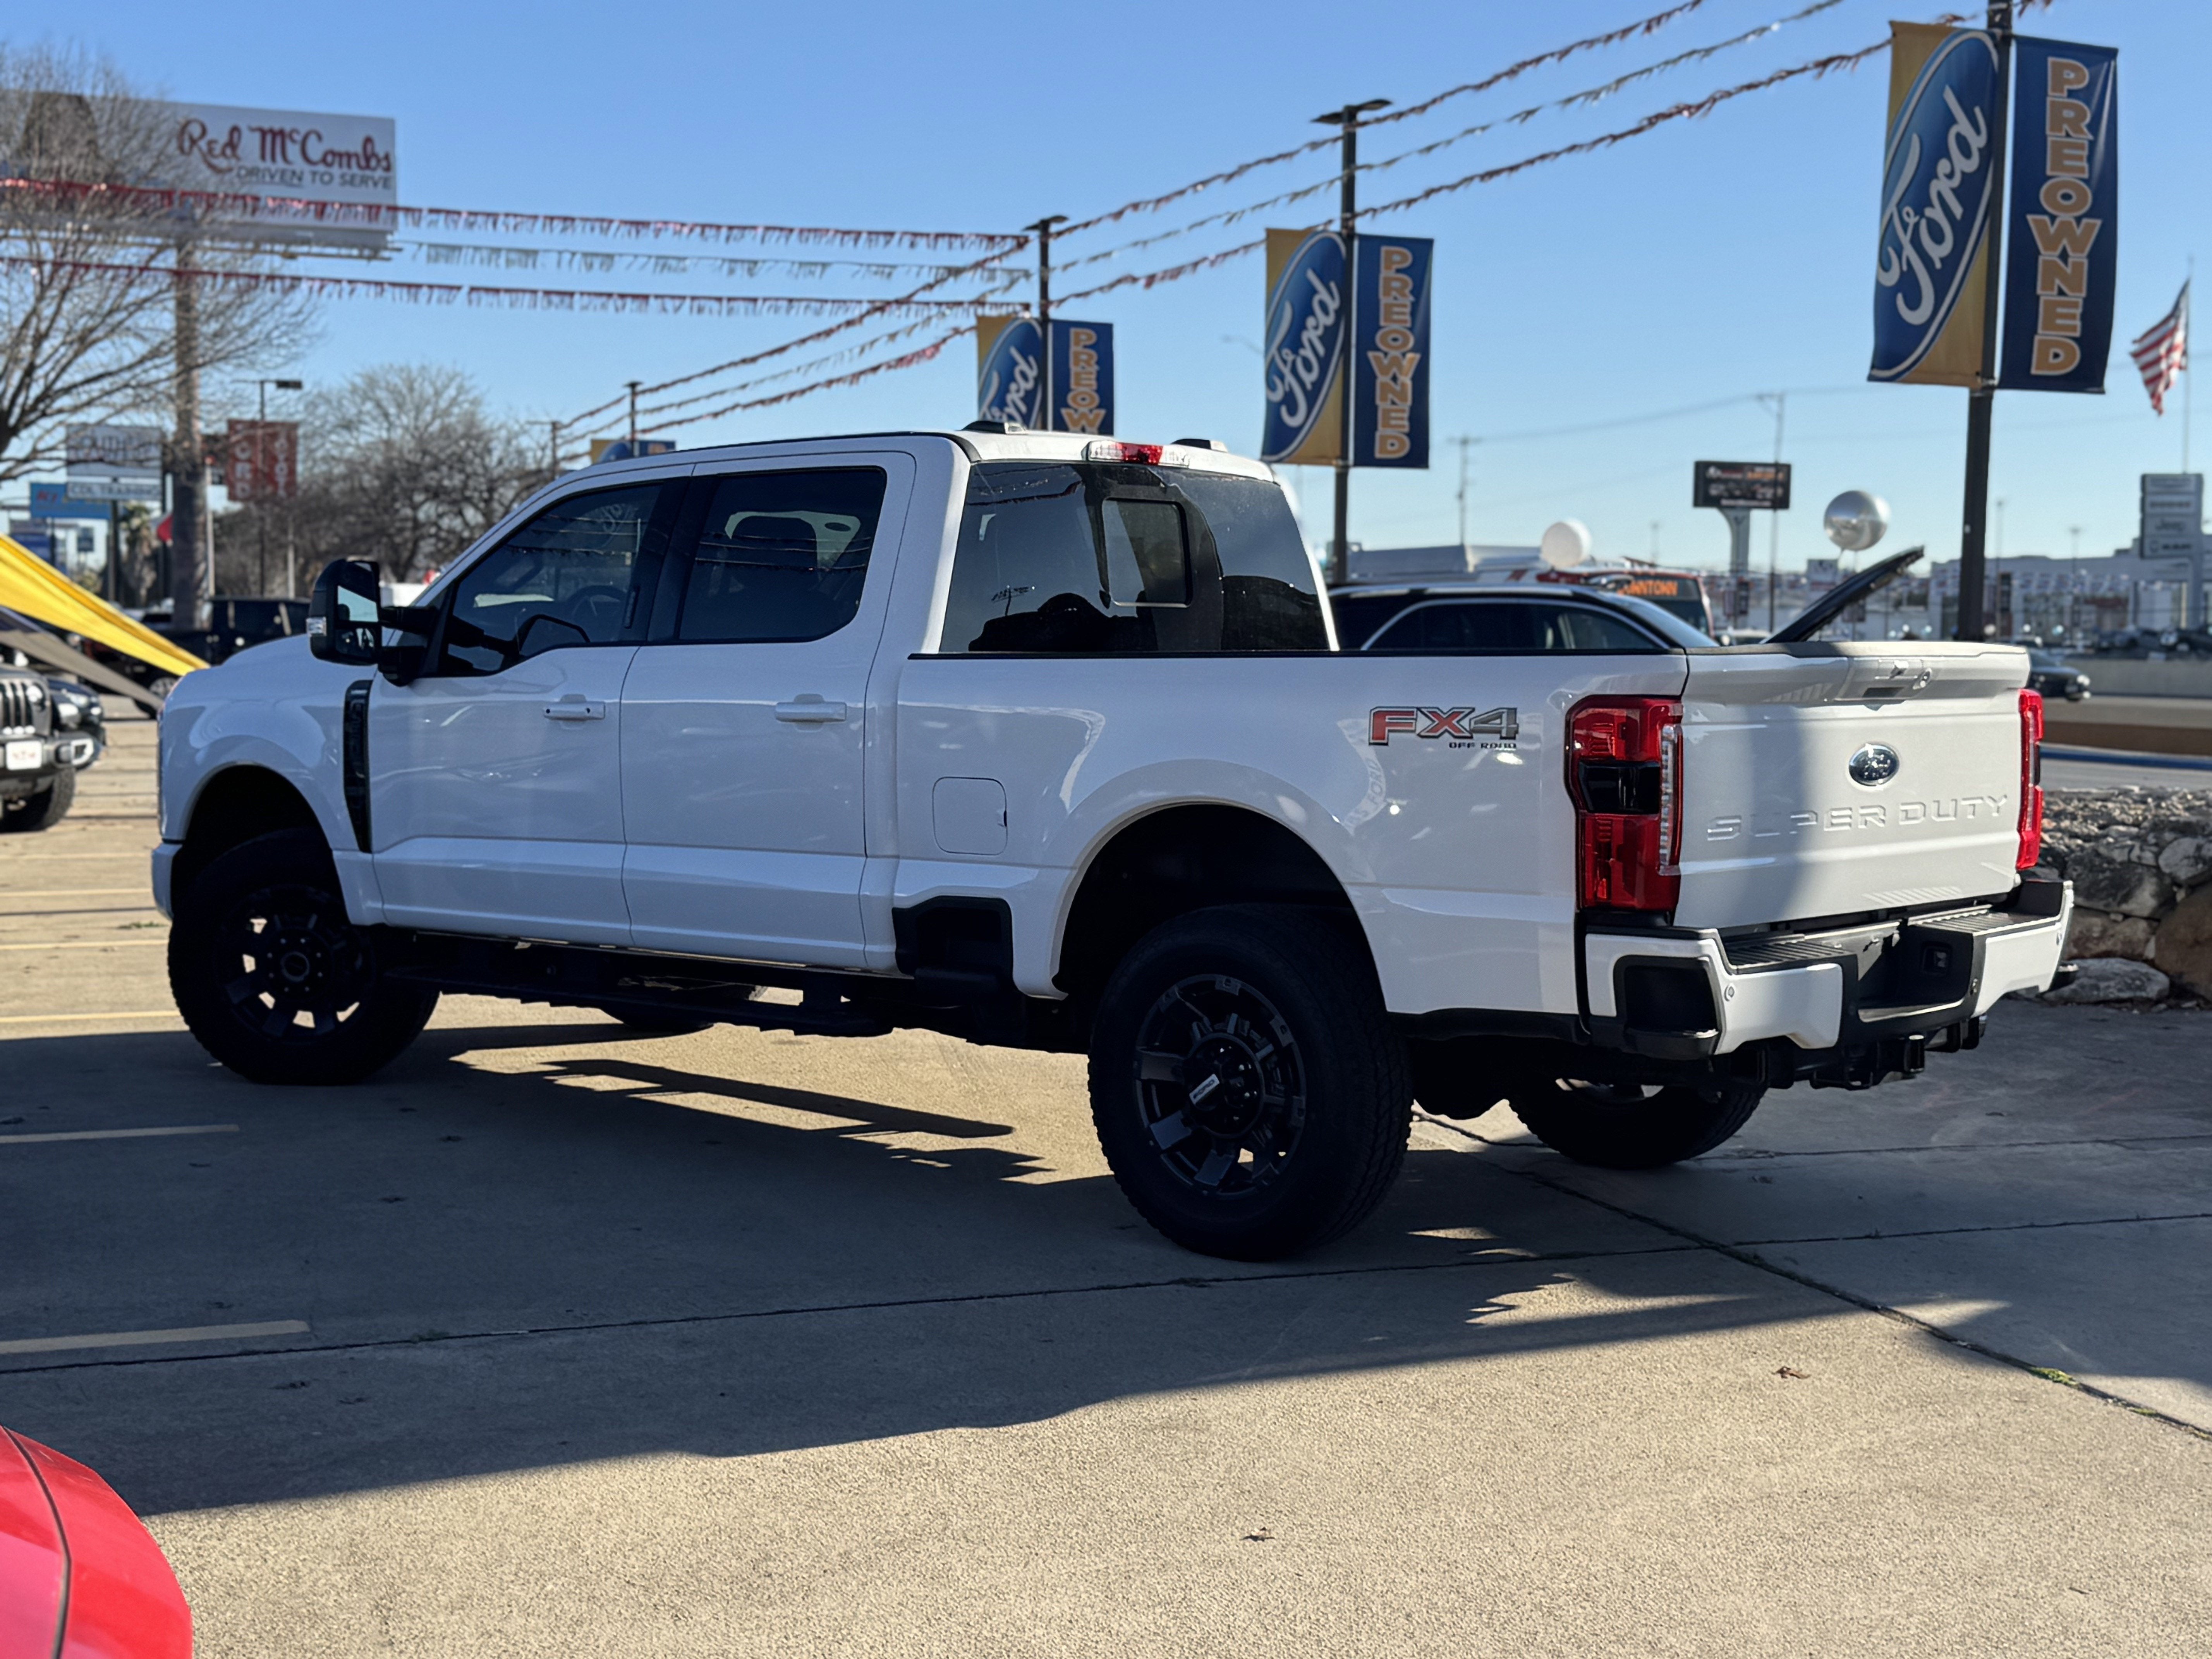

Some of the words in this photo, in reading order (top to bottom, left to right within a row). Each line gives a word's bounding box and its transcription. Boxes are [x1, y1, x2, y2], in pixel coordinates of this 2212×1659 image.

[178, 118, 241, 173] Red
[248, 125, 392, 172] McCombs
[236, 165, 304, 184] DRIVEN
[310, 172, 333, 185] TO
[339, 173, 393, 190] SERVE
[1876, 84, 1987, 326] Ford
[2026, 56, 2103, 376] PREOWNED
[1060, 328, 1106, 432] PREOW
[1266, 268, 1341, 428] Ford
[1366, 246, 1421, 459] PREOWNED
[1369, 706, 1518, 746] FX4
[1898, 793, 2008, 826] DUTY
